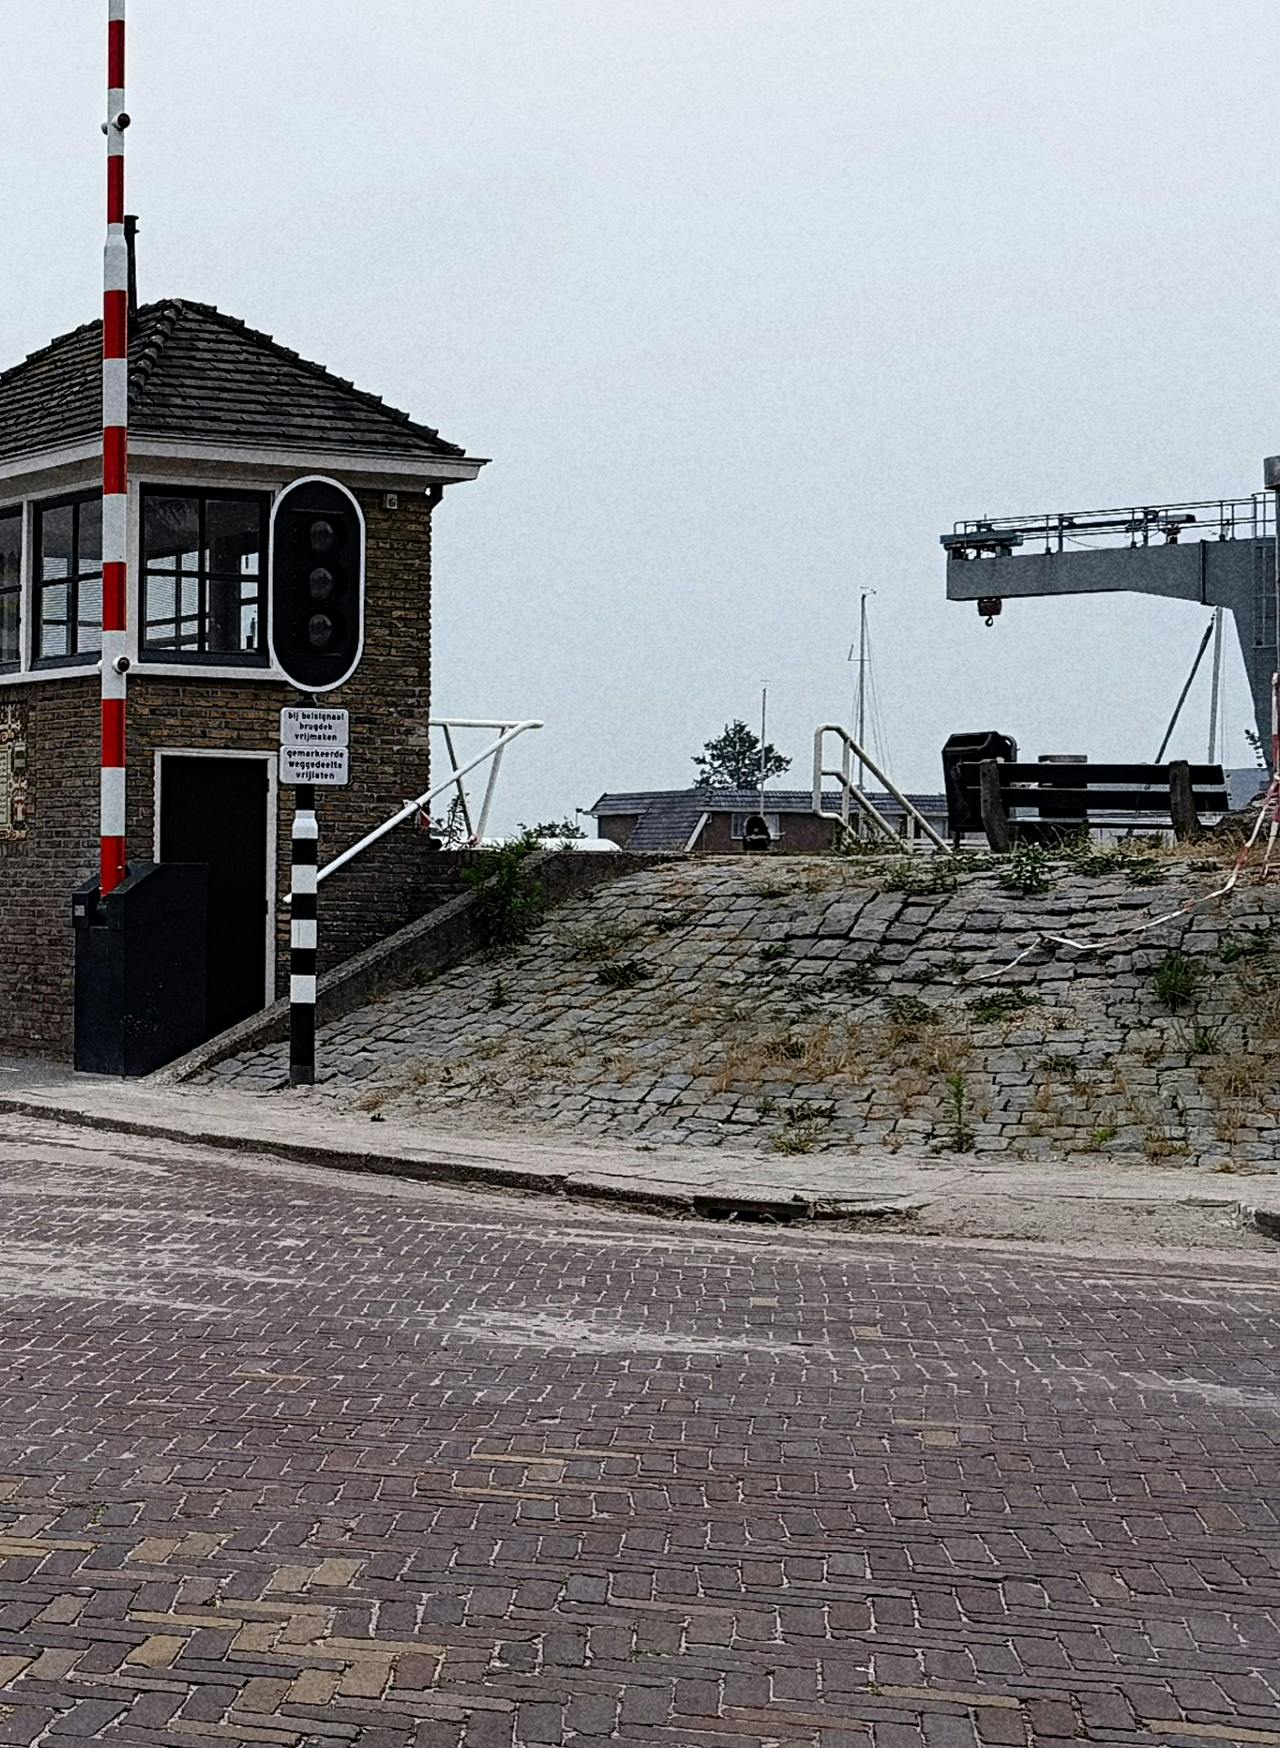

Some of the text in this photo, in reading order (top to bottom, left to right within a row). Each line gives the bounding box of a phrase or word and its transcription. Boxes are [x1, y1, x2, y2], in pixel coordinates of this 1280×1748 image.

[287, 711, 345, 722] bij belsignaal
[299, 722, 333, 732] brugdek
[294, 732, 338, 742] vrijmaken
[286, 749, 344, 759] gemarkeerde
[288, 760, 343, 770] weggedeelte
[295, 771, 335, 782] vrijlaten
